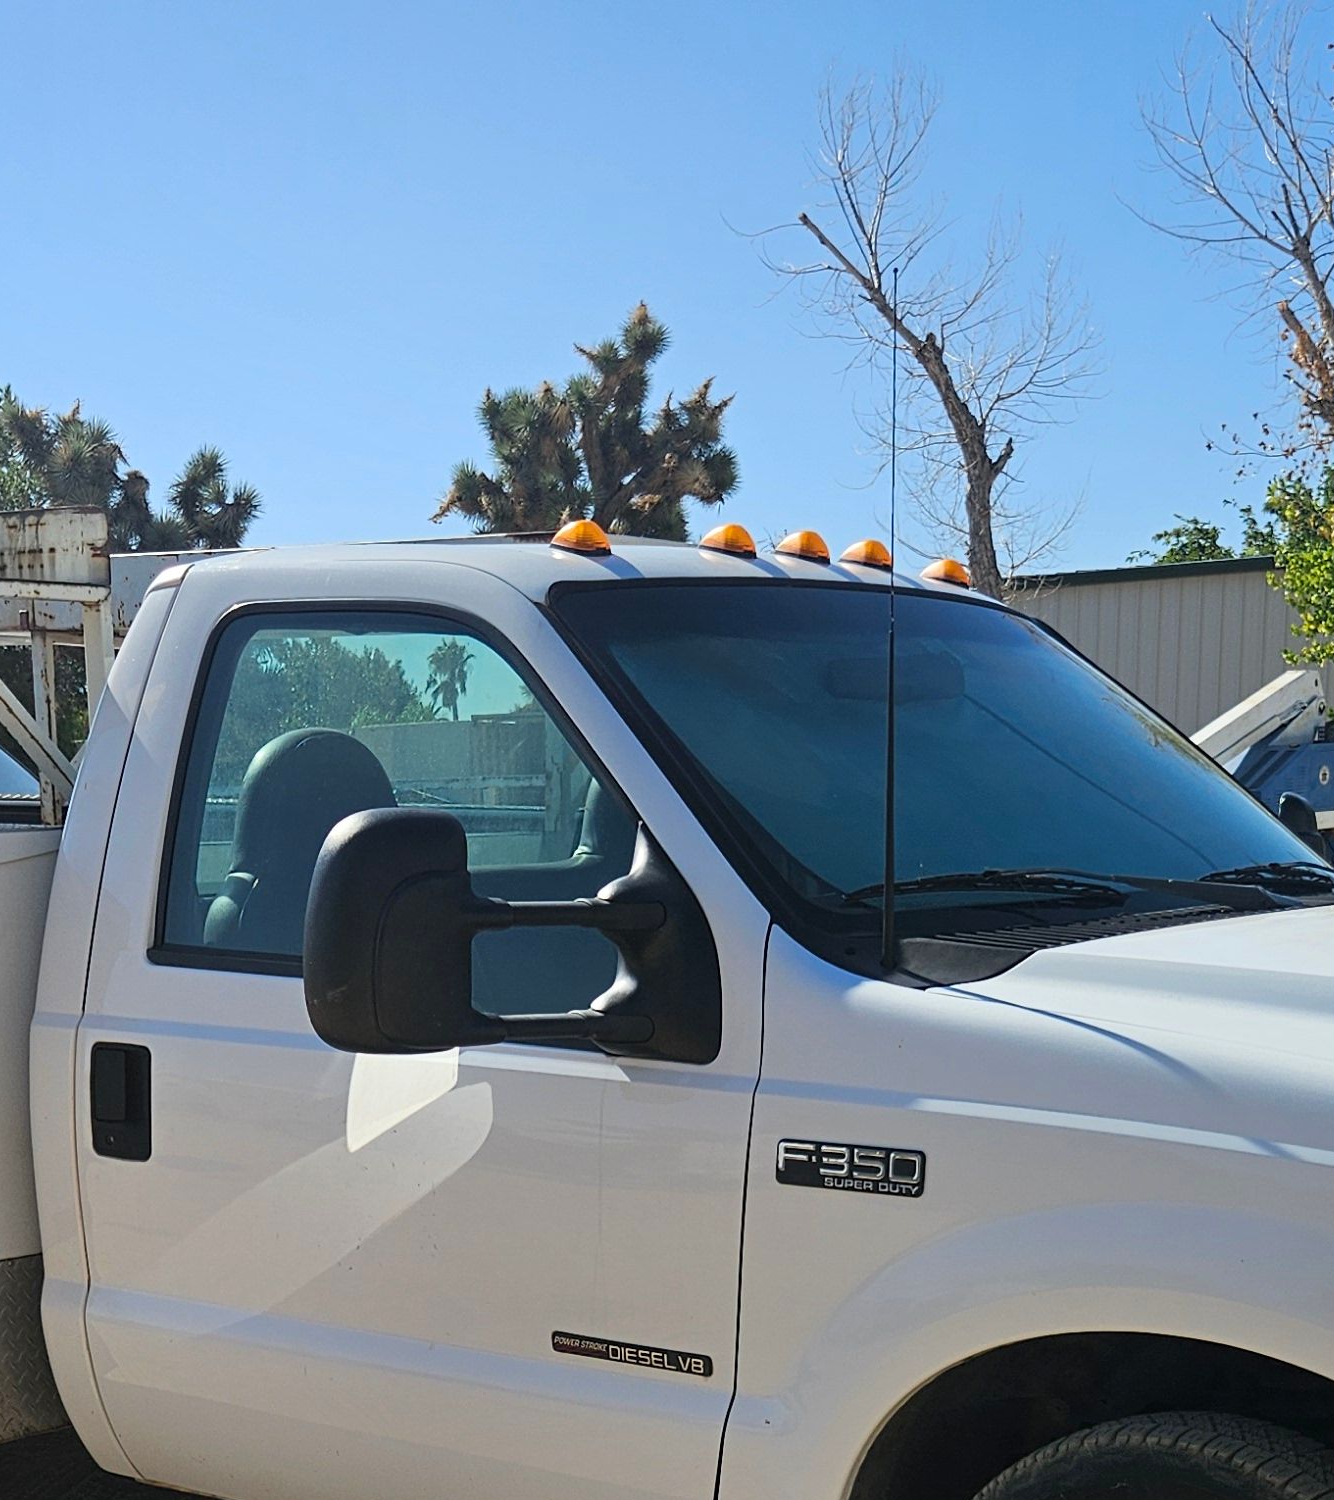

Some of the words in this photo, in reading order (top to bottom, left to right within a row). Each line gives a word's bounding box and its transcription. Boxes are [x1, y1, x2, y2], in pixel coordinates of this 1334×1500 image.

[823, 1177, 874, 1191] SUPER
[878, 1182, 919, 1195] DUTY
[553, 1335, 580, 1347] POWER
[580, 1340, 608, 1352] STROKE
[608, 1345, 676, 1370] DIESEL
[677, 1355, 704, 1374] V8
